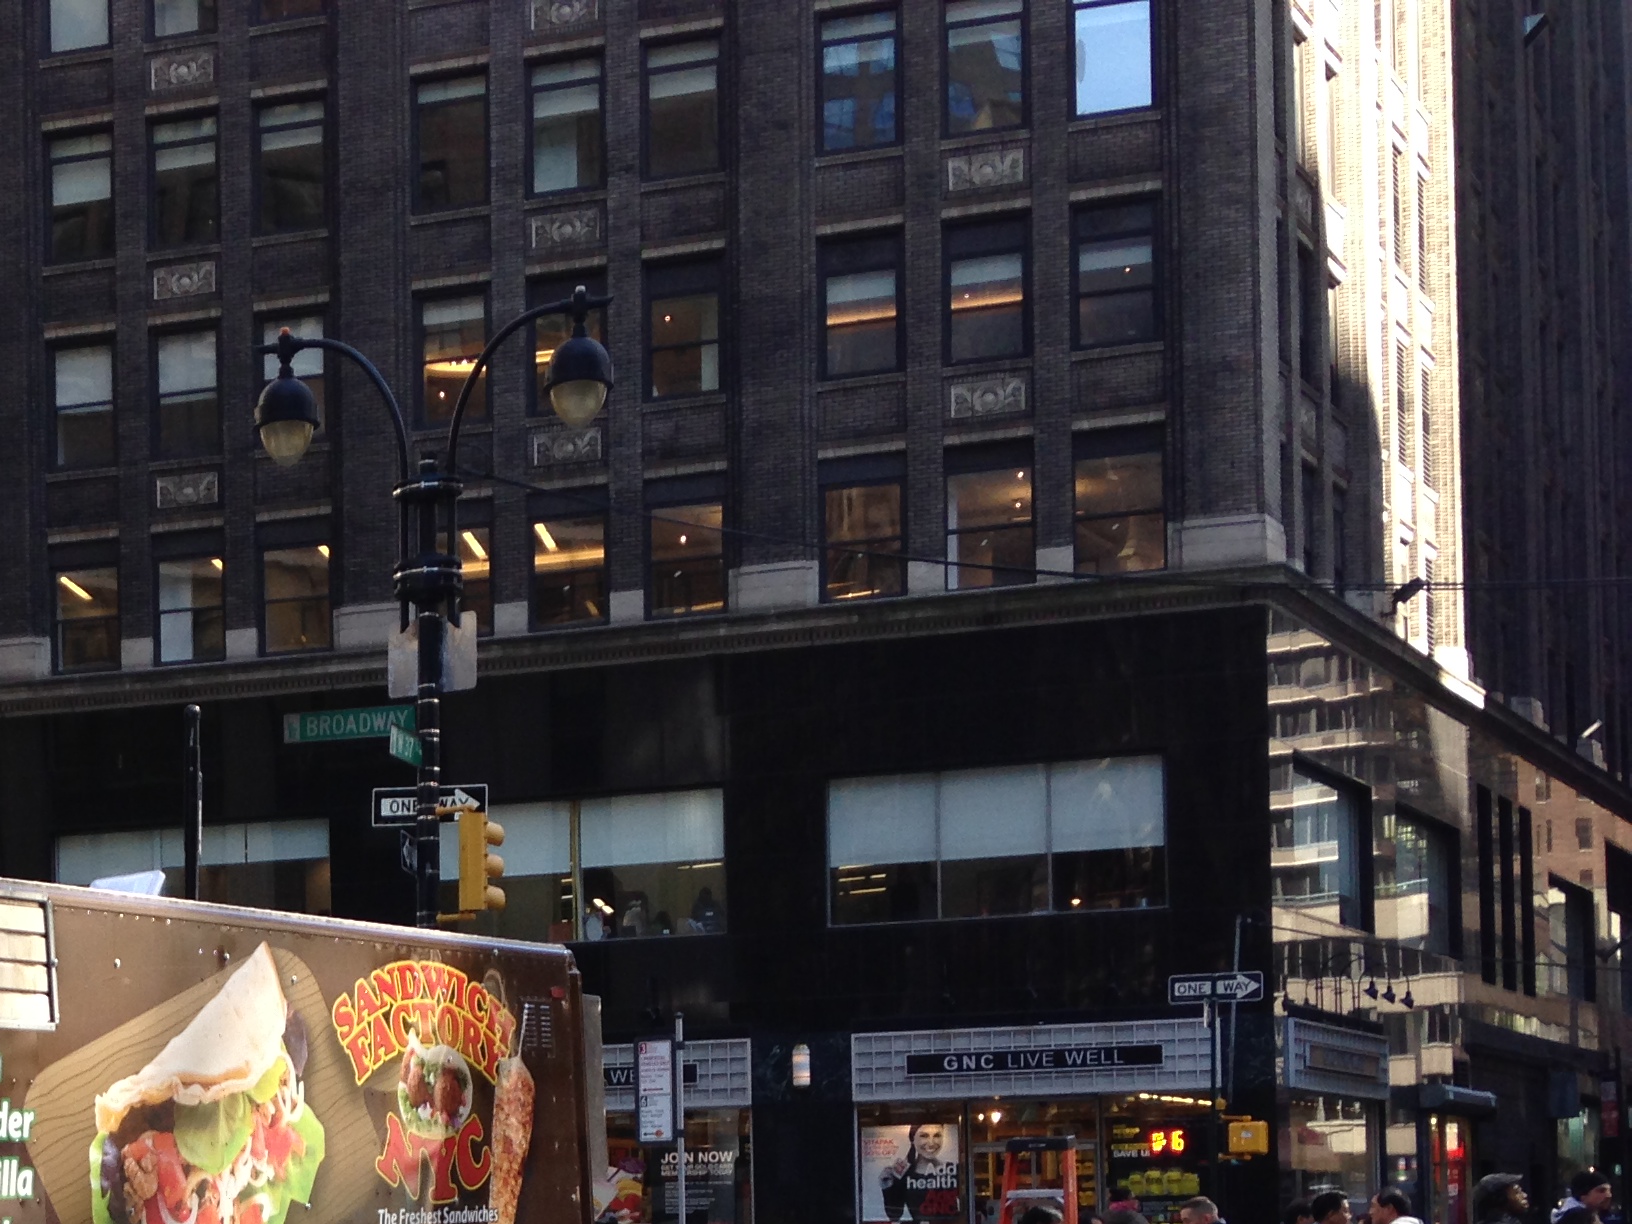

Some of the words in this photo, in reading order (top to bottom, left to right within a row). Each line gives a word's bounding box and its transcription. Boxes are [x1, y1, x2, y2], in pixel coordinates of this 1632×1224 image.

[306, 709, 409, 736] BROADWAY
[1177, 983, 1207, 994] ONE
[1223, 980, 1252, 993] WAY
[332, 960, 516, 1058] SANDWICH
[345, 1000, 509, 1086] FACTORY
[943, 1054, 994, 1071] GNC
[1007, 1052, 1055, 1068] LIVE
[1064, 1049, 1125, 1065] WELL
[375, 1112, 492, 1204] NYC
[660, 1152, 694, 1164] JON
[698, 1151, 733, 1163] NOW
[924, 1161, 957, 1176] Add
[906, 1175, 957, 1189] health
[443, 1205, 499, 1224] Sandwiches
